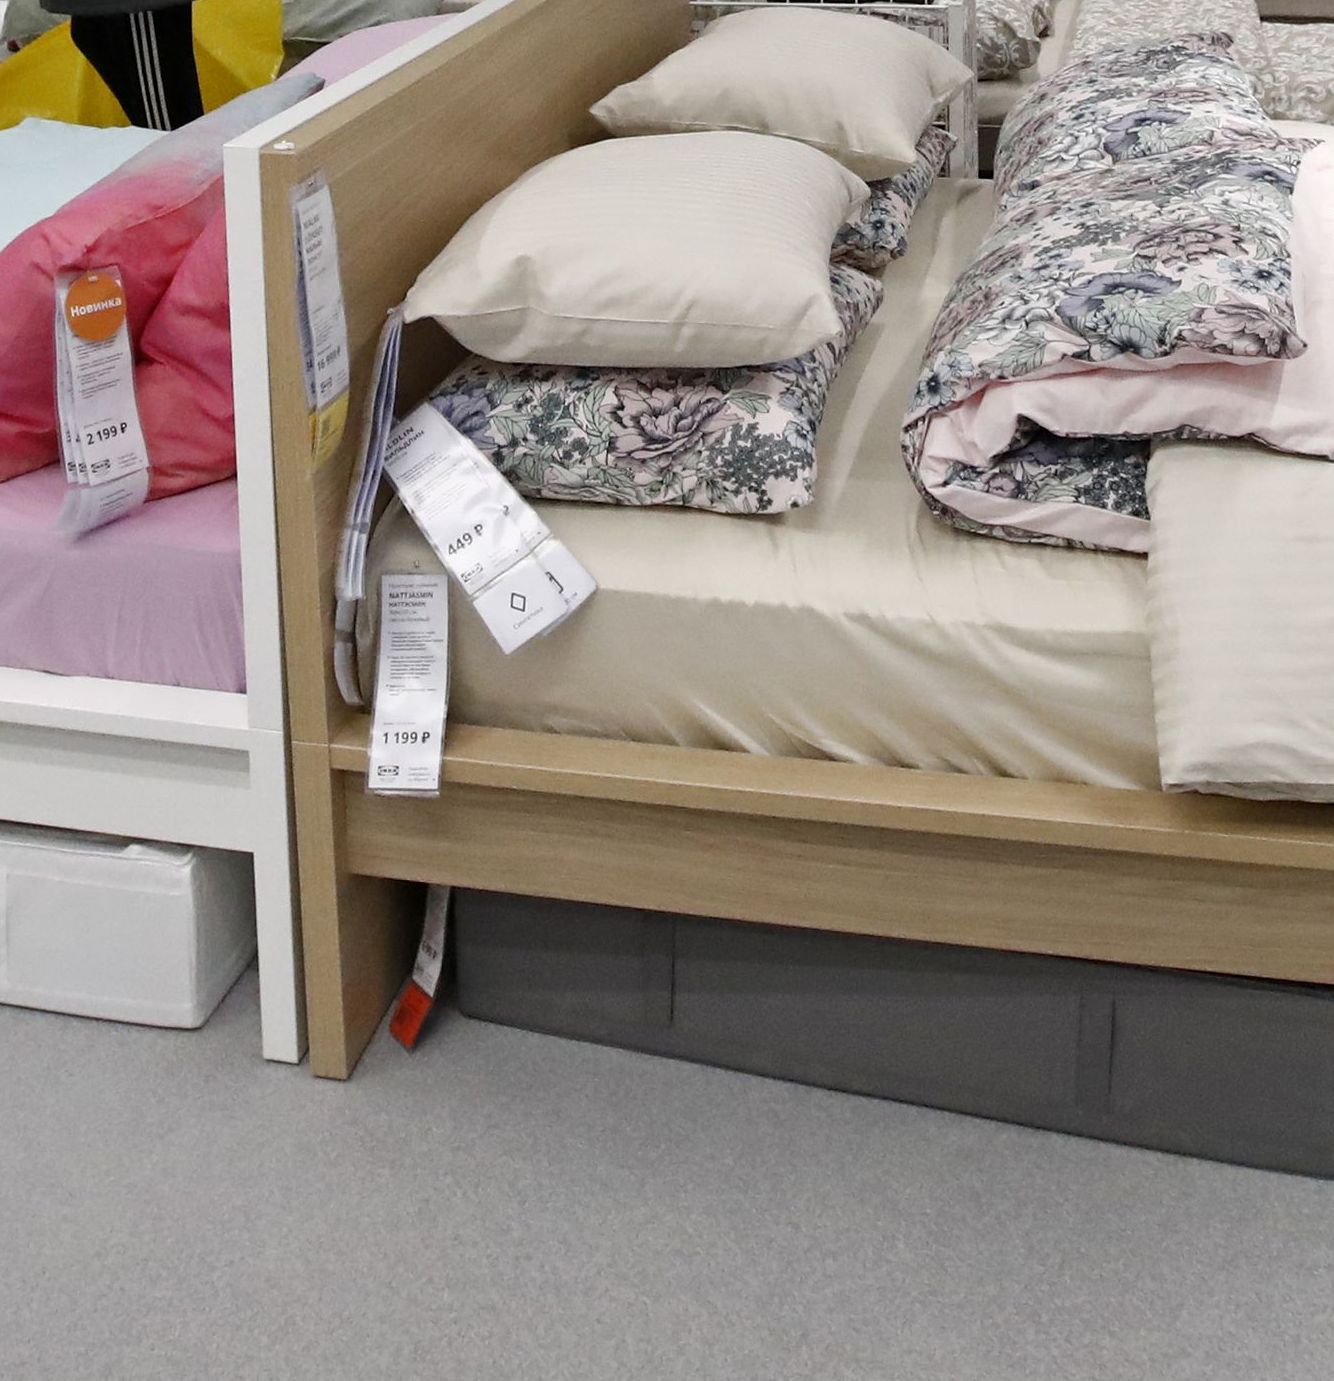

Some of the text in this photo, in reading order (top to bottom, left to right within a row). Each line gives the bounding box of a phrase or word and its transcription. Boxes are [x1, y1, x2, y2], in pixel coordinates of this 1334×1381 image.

[70, 297, 123, 317] Новинка
[86, 433, 95, 445] 2
[96, 425, 118, 442] 199
[447, 532, 474, 557] 449
[383, 731, 389, 744] 1
[394, 731, 418, 745] 199
